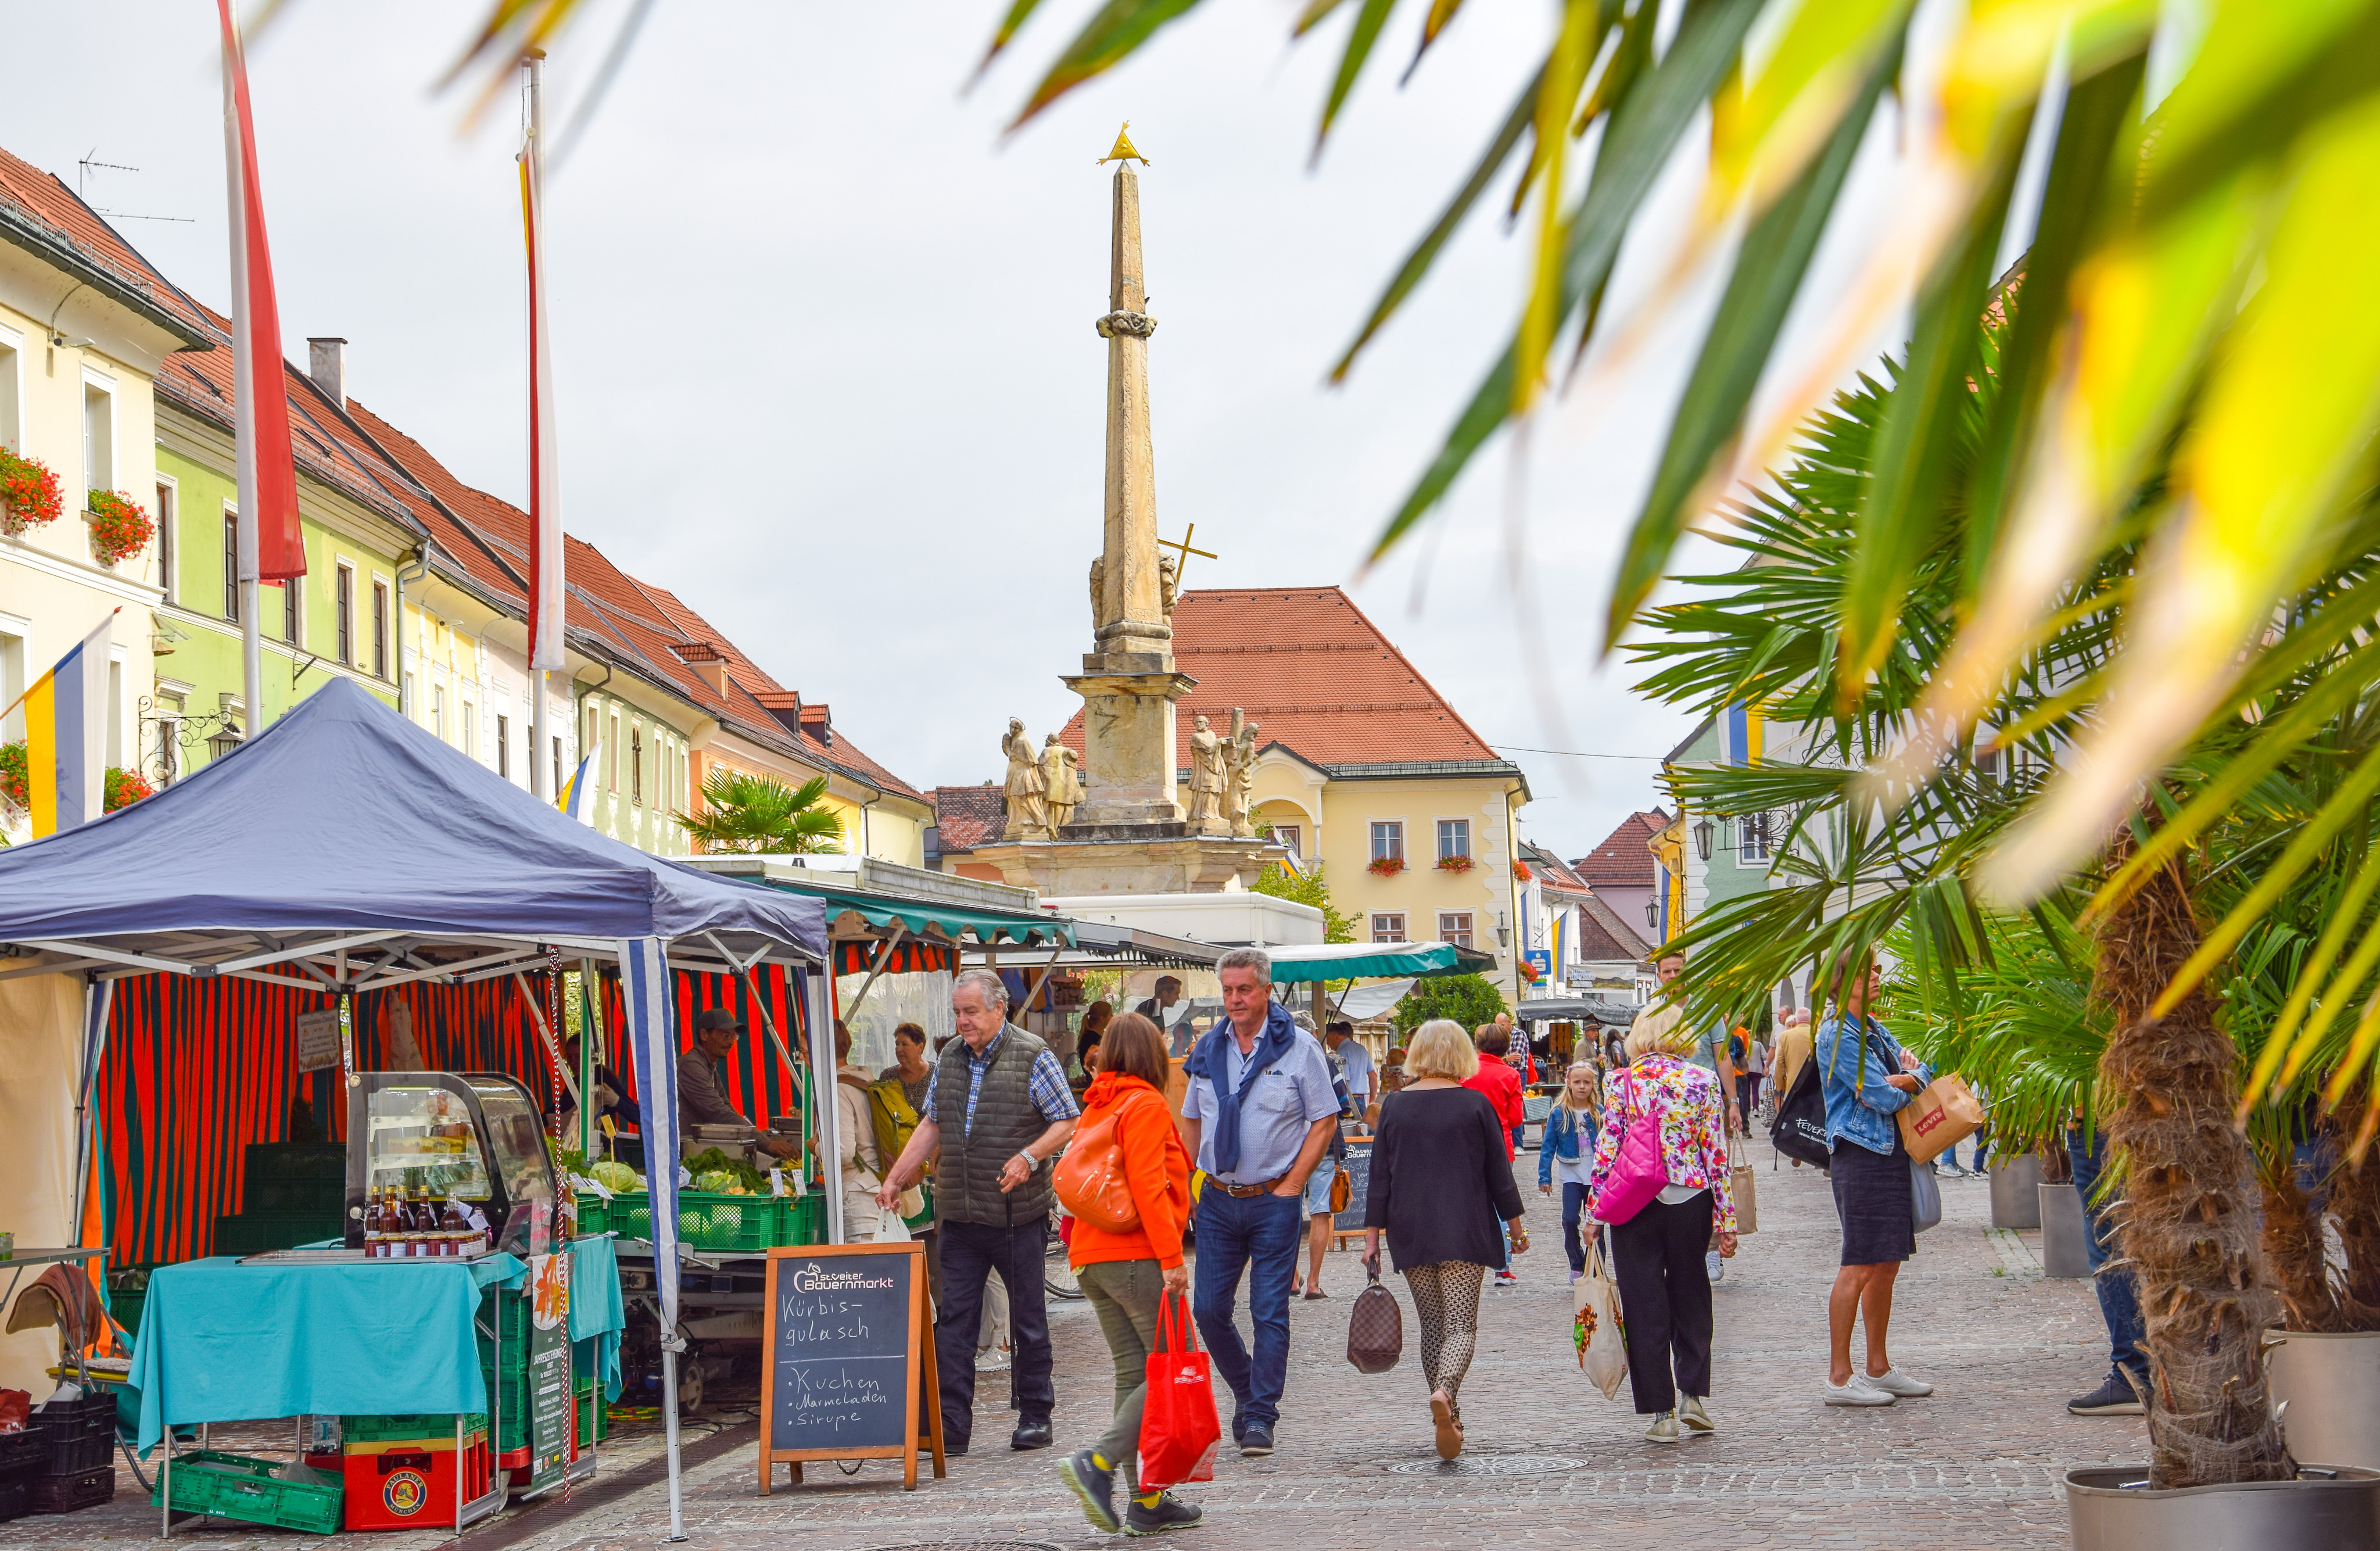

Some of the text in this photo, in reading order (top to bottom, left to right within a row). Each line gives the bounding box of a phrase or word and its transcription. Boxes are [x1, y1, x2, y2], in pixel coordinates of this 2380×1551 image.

[804, 1277, 894, 1291] Bauernmarkt
[782, 1294, 863, 1323] Kürbis-
[786, 1317, 869, 1346] gulasch
[791, 1367, 879, 1394] Kuchen
[795, 1389, 887, 1410] Marmeladen
[797, 1413, 861, 1431] Sirupe
[386, 1473, 423, 1489] PAULANER
